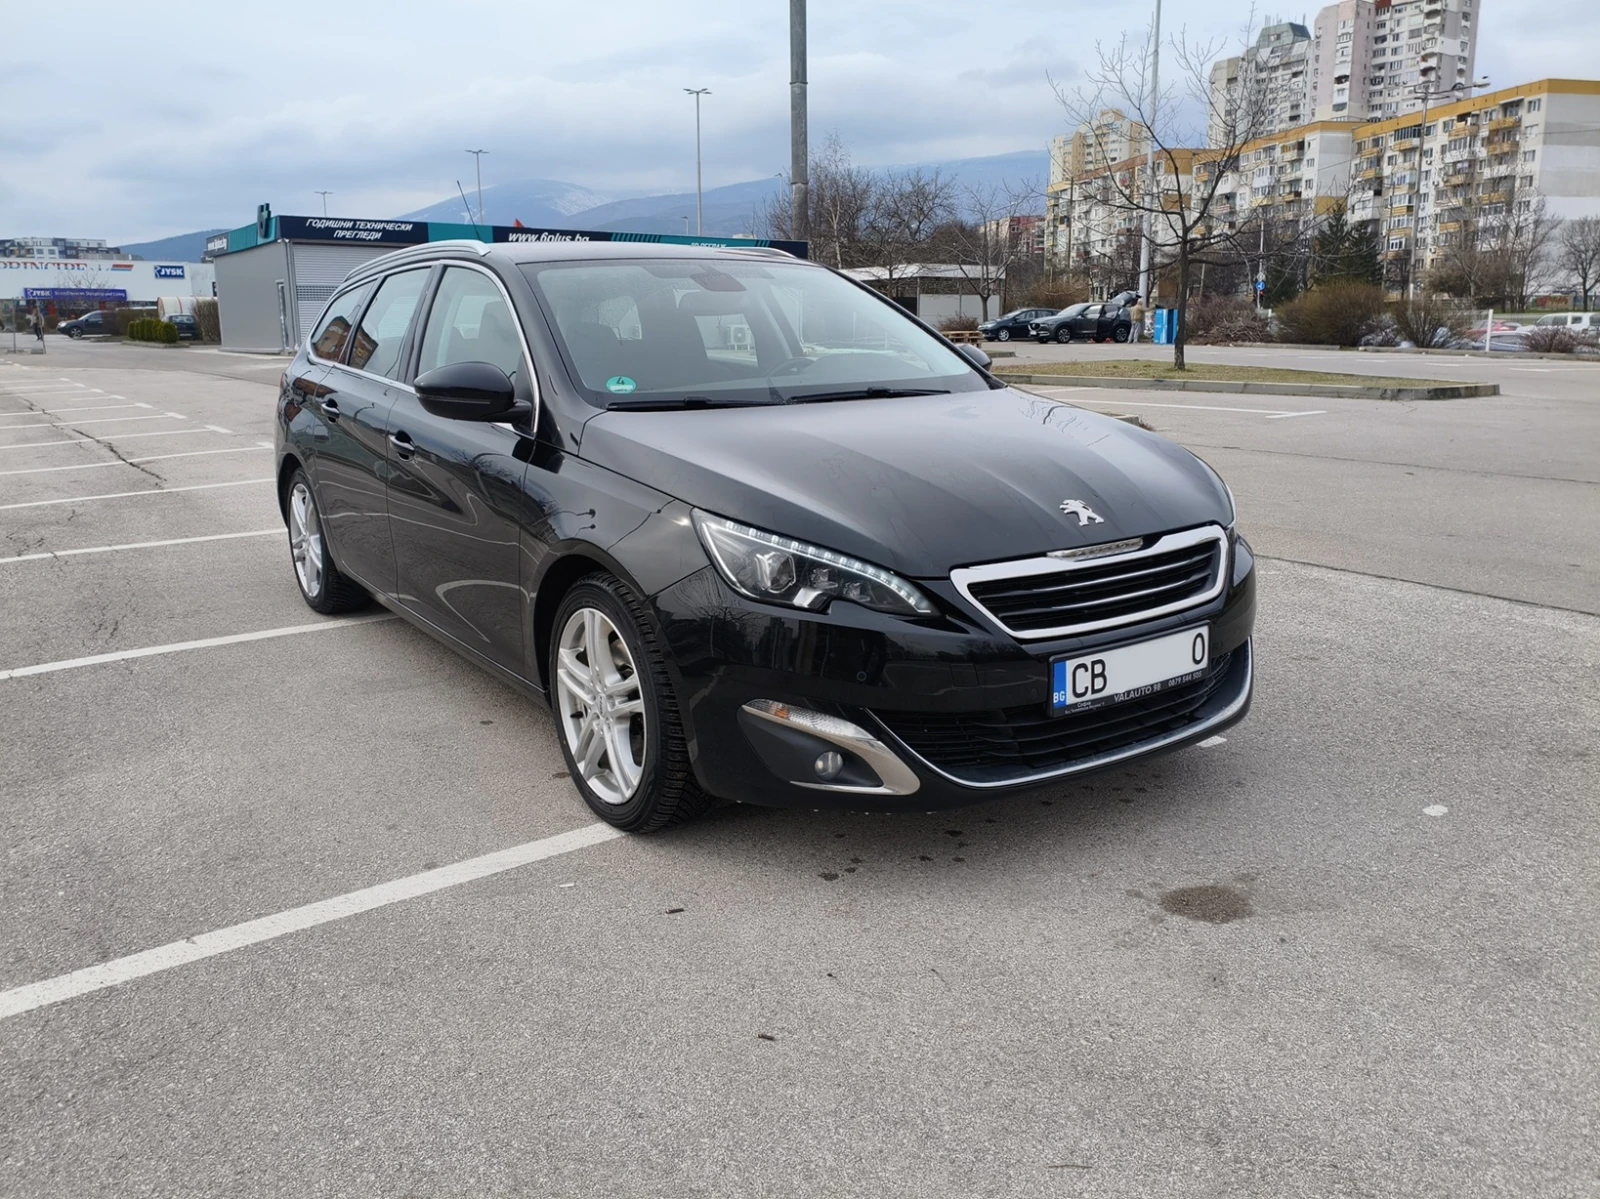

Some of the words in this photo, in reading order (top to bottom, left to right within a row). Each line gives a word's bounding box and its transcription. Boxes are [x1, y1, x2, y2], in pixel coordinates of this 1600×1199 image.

[306, 218, 353, 229] ГОДИШНИ
[355, 221, 413, 231] ТЕХНИЧЕСКИ
[333, 230, 382, 240] ПРЕГЛЕДИ
[616, 376, 625, 385] 4
[1072, 658, 1107, 698] CB
[1114, 686, 1151, 702] VALAUTO
[1153, 682, 1161, 692] 98
[1168, 676, 1181, 687] 0879
[1183, 674, 1192, 683] 544
[1053, 691, 1065, 703] BG
